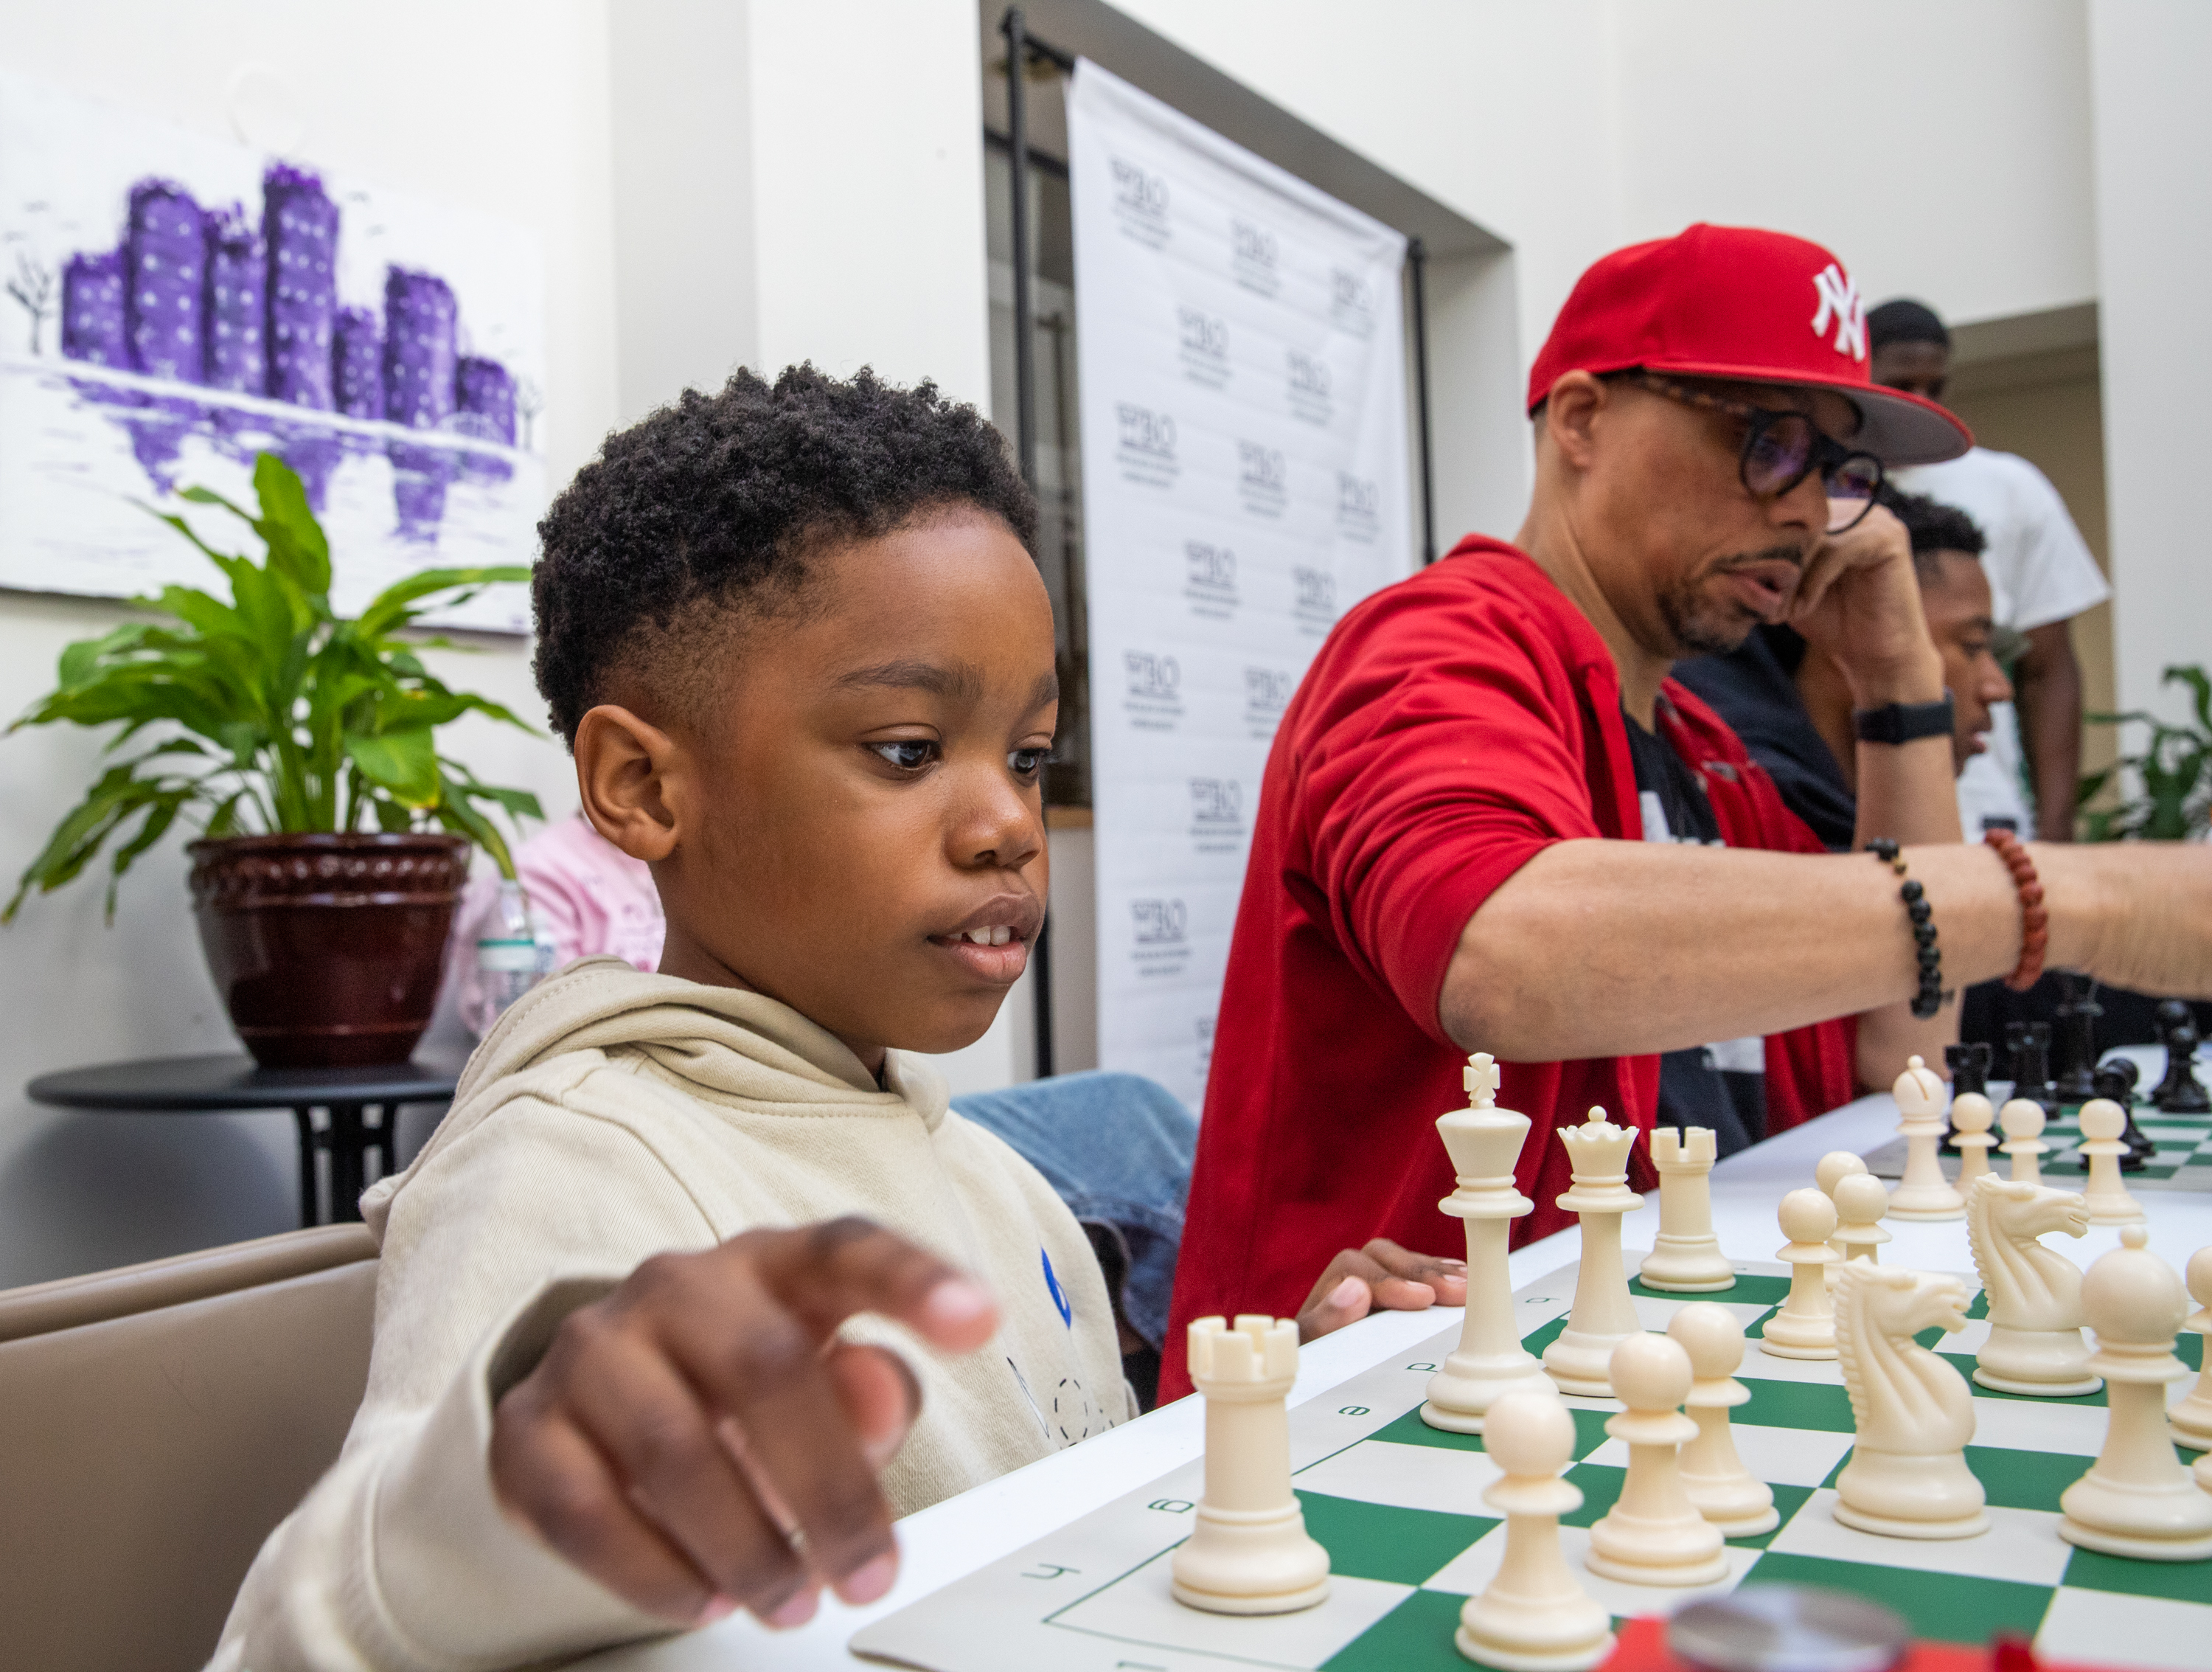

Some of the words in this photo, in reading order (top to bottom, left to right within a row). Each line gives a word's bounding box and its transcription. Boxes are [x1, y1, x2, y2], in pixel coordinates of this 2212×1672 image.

[1811, 263, 1867, 362] NY
[1338, 1406, 1371, 1415] e
[1147, 1499, 1194, 1513] g
[1020, 1563, 1081, 1581] h
